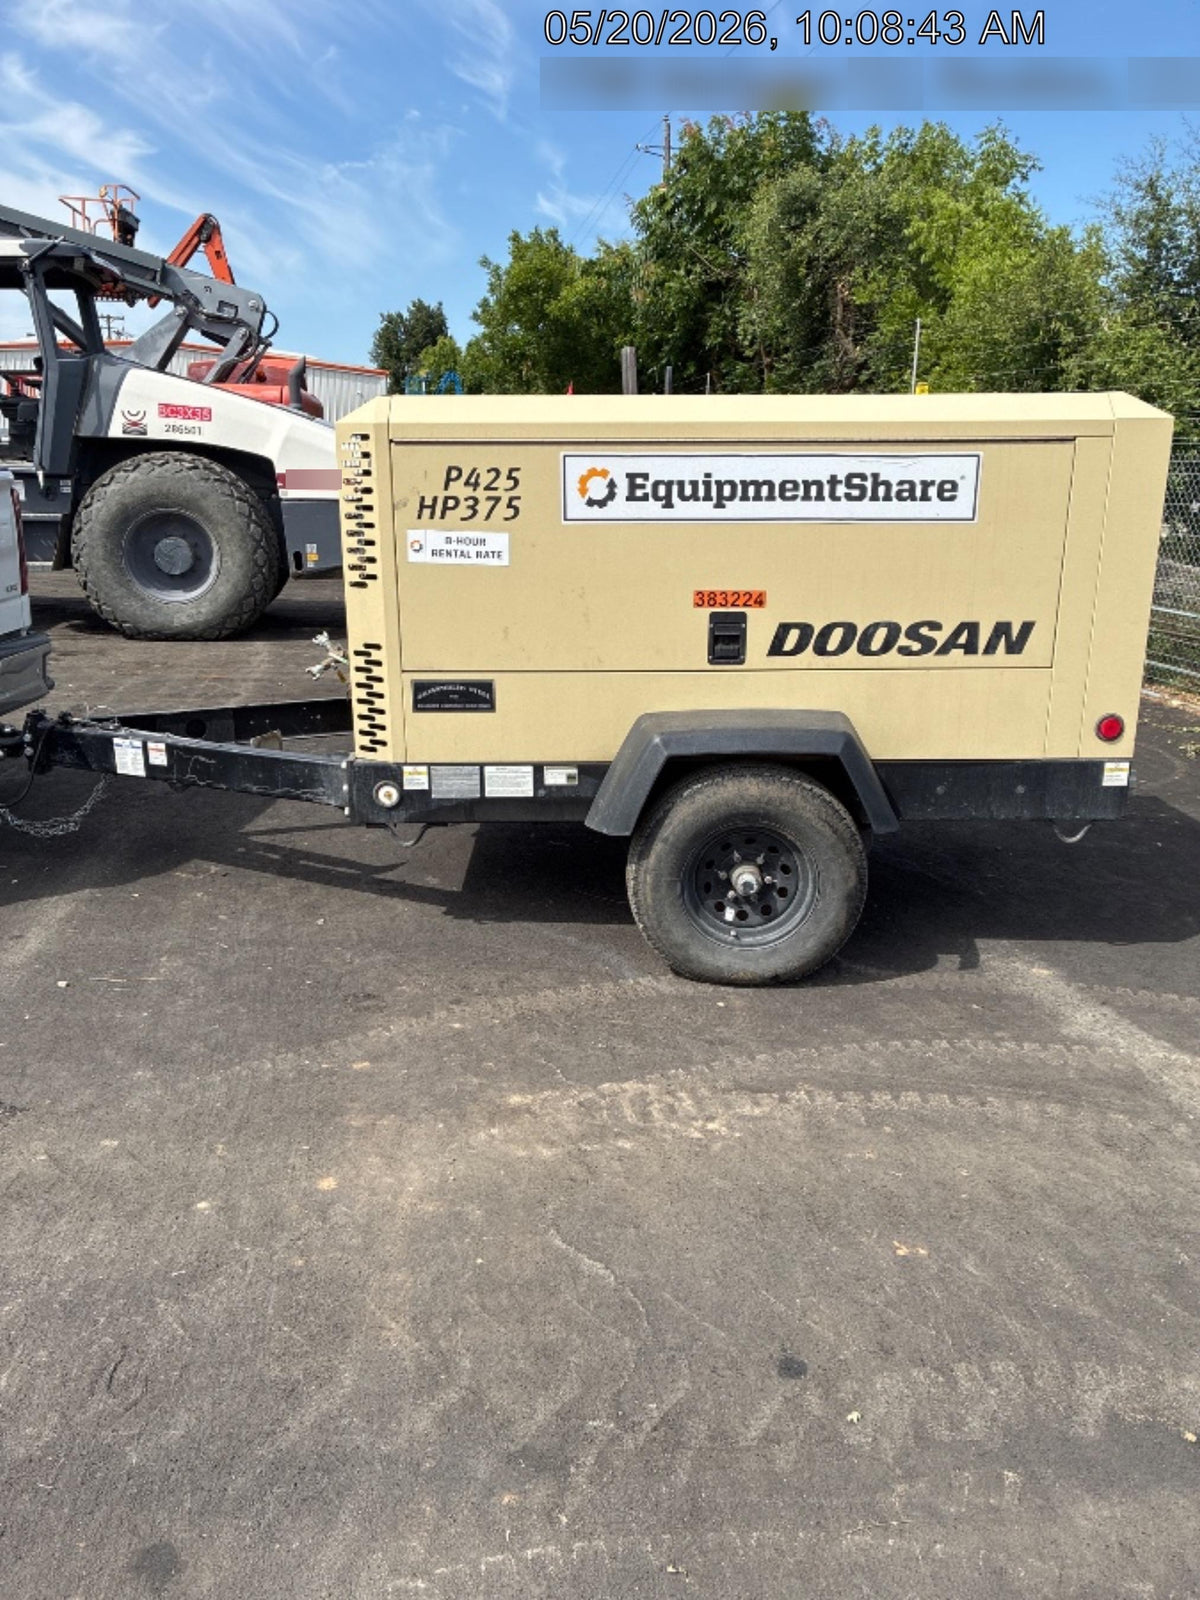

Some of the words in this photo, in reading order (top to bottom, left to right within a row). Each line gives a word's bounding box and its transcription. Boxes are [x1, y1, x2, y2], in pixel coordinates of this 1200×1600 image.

[443, 465, 522, 492] P425
[625, 472, 959, 509] EquipmentShare
[416, 495, 522, 521] HP375
[431, 548, 472, 559] RENTAL
[475, 550, 504, 560] RATE
[694, 590, 766, 608] 383224
[766, 620, 1036, 657] DOOSAN
